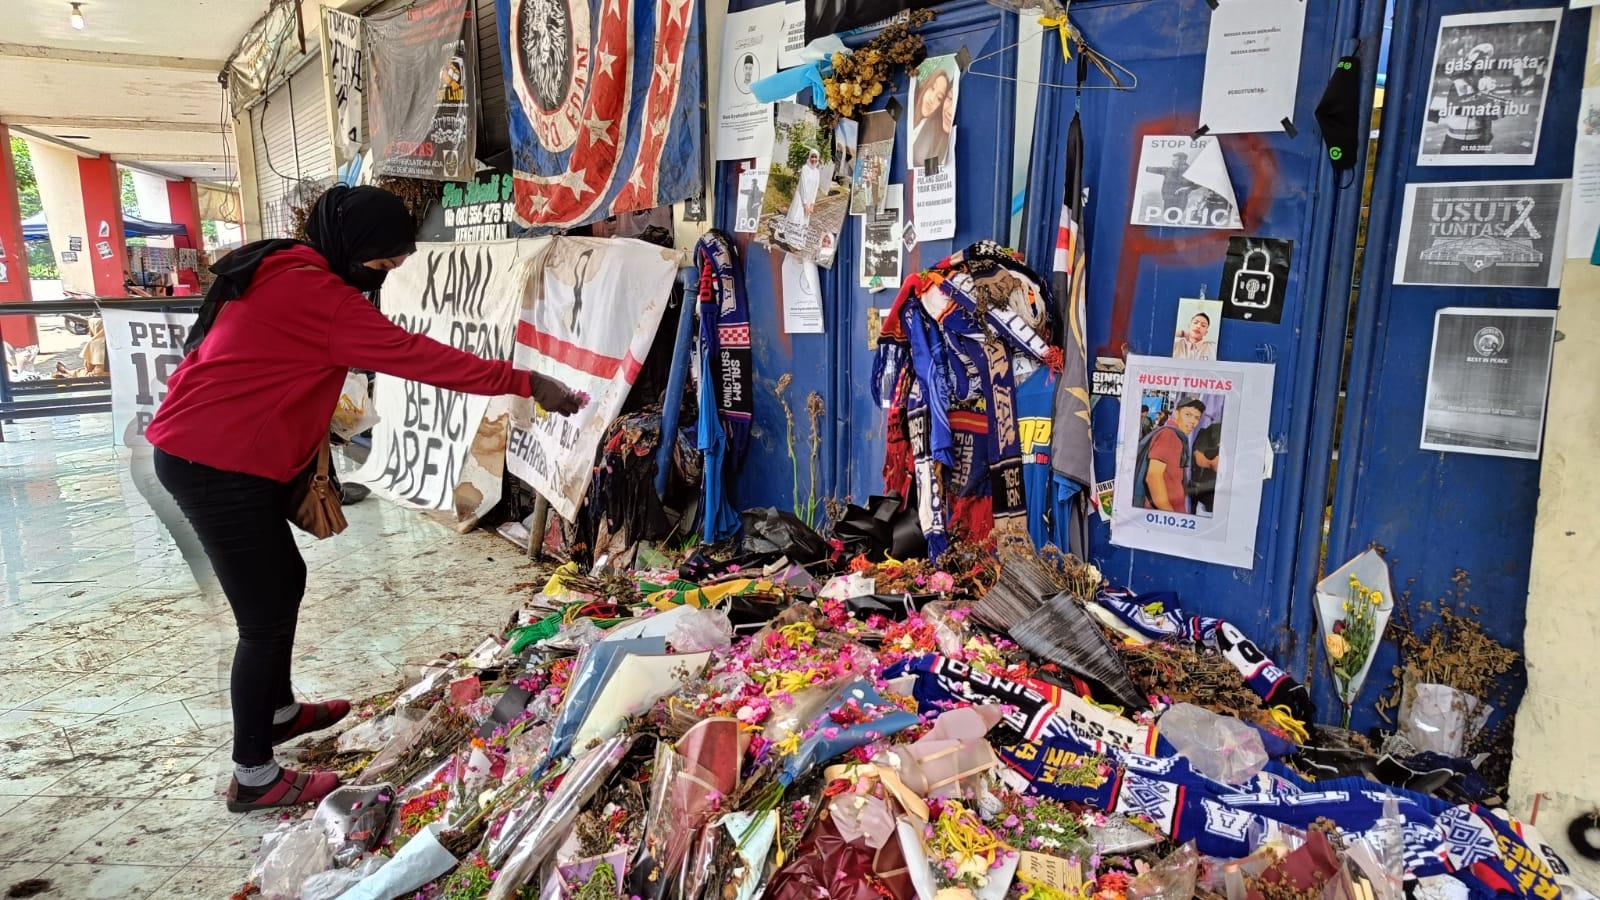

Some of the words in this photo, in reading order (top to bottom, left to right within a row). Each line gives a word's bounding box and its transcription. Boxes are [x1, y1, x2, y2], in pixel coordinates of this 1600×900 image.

[1445, 59, 1473, 75] gas
[1474, 56, 1496, 71] air
[1438, 102, 1459, 117] air
[1461, 102, 1501, 116] mata
[1503, 101, 1530, 116] ibu
[1151, 139, 1186, 149] STOP
[1431, 202, 1514, 222] USUT
[1429, 222, 1506, 236] TUNTAS
[421, 247, 493, 320] KAMI
[731, 359, 742, 401] SALAM
[1138, 373, 1181, 387] #USUT
[1183, 377, 1233, 391] TUNTAS
[403, 380, 468, 443] BENCI
[1145, 513, 1197, 530] 01.10.22
